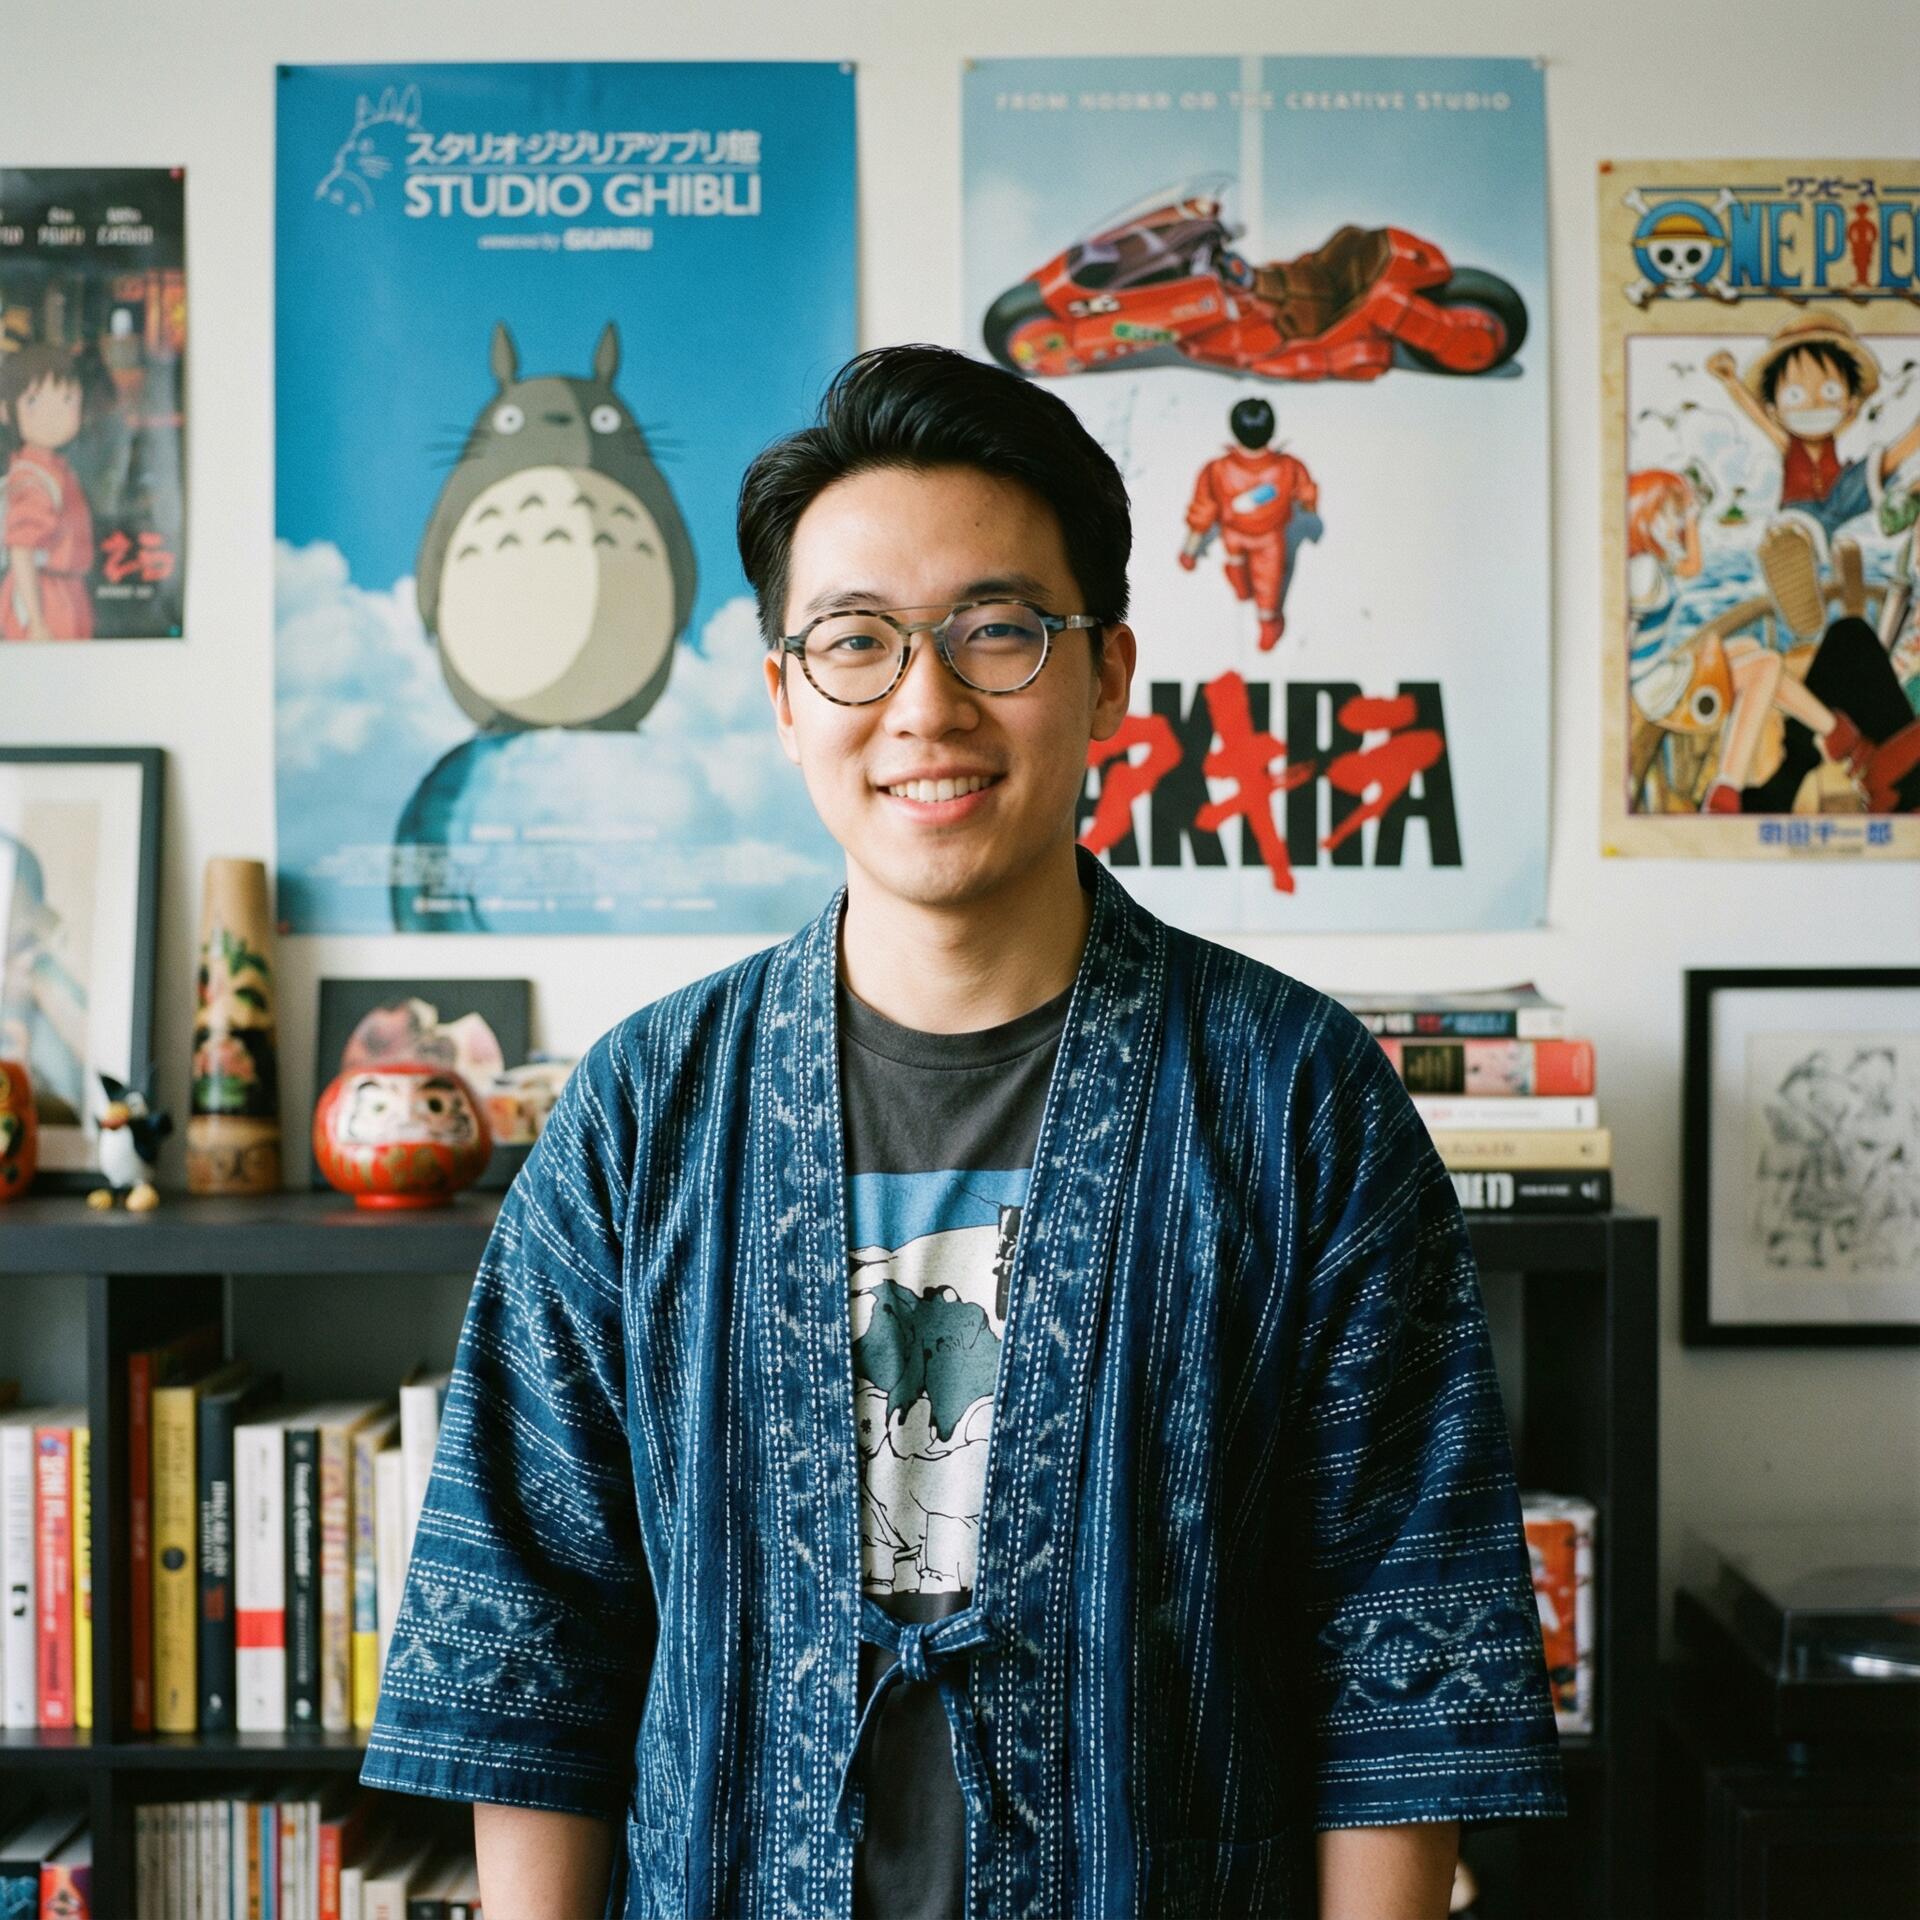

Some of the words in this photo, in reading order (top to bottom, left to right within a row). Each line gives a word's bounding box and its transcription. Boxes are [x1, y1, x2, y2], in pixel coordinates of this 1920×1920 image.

[1286, 92, 1403, 110] CREATIVE
[1416, 92, 1511, 111] STUDIO
[404, 173, 592, 218] STUDIO
[603, 173, 762, 217] GHIBLI
[1814, 201, 1920, 289] PIE
[1075, 671, 1444, 894] アキラ
